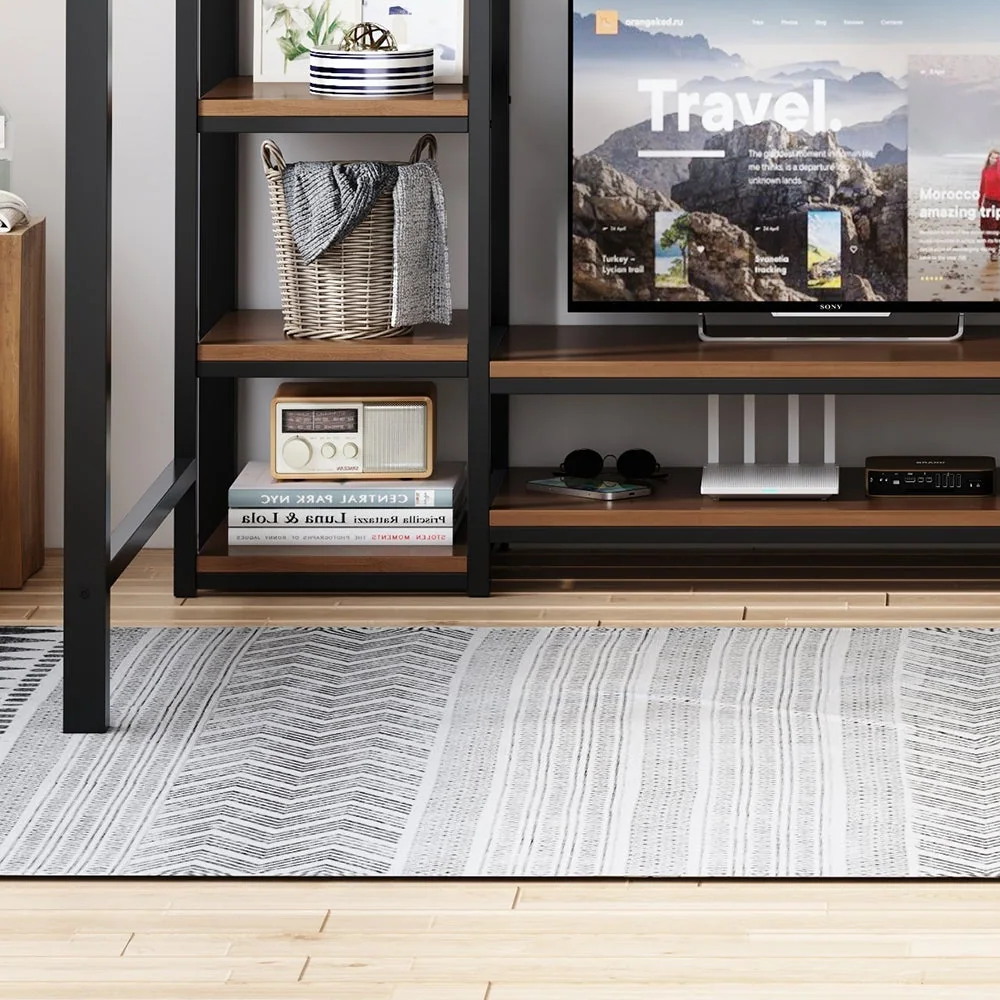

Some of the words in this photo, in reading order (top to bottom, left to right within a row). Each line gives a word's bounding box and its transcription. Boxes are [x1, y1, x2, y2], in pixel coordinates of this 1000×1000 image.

[638, 78, 842, 132] Travel.
[748, 149, 762, 158] The
[920, 187, 981, 200] Morocco
[920, 205, 977, 220] amazing
[602, 255, 628, 265] Turkey
